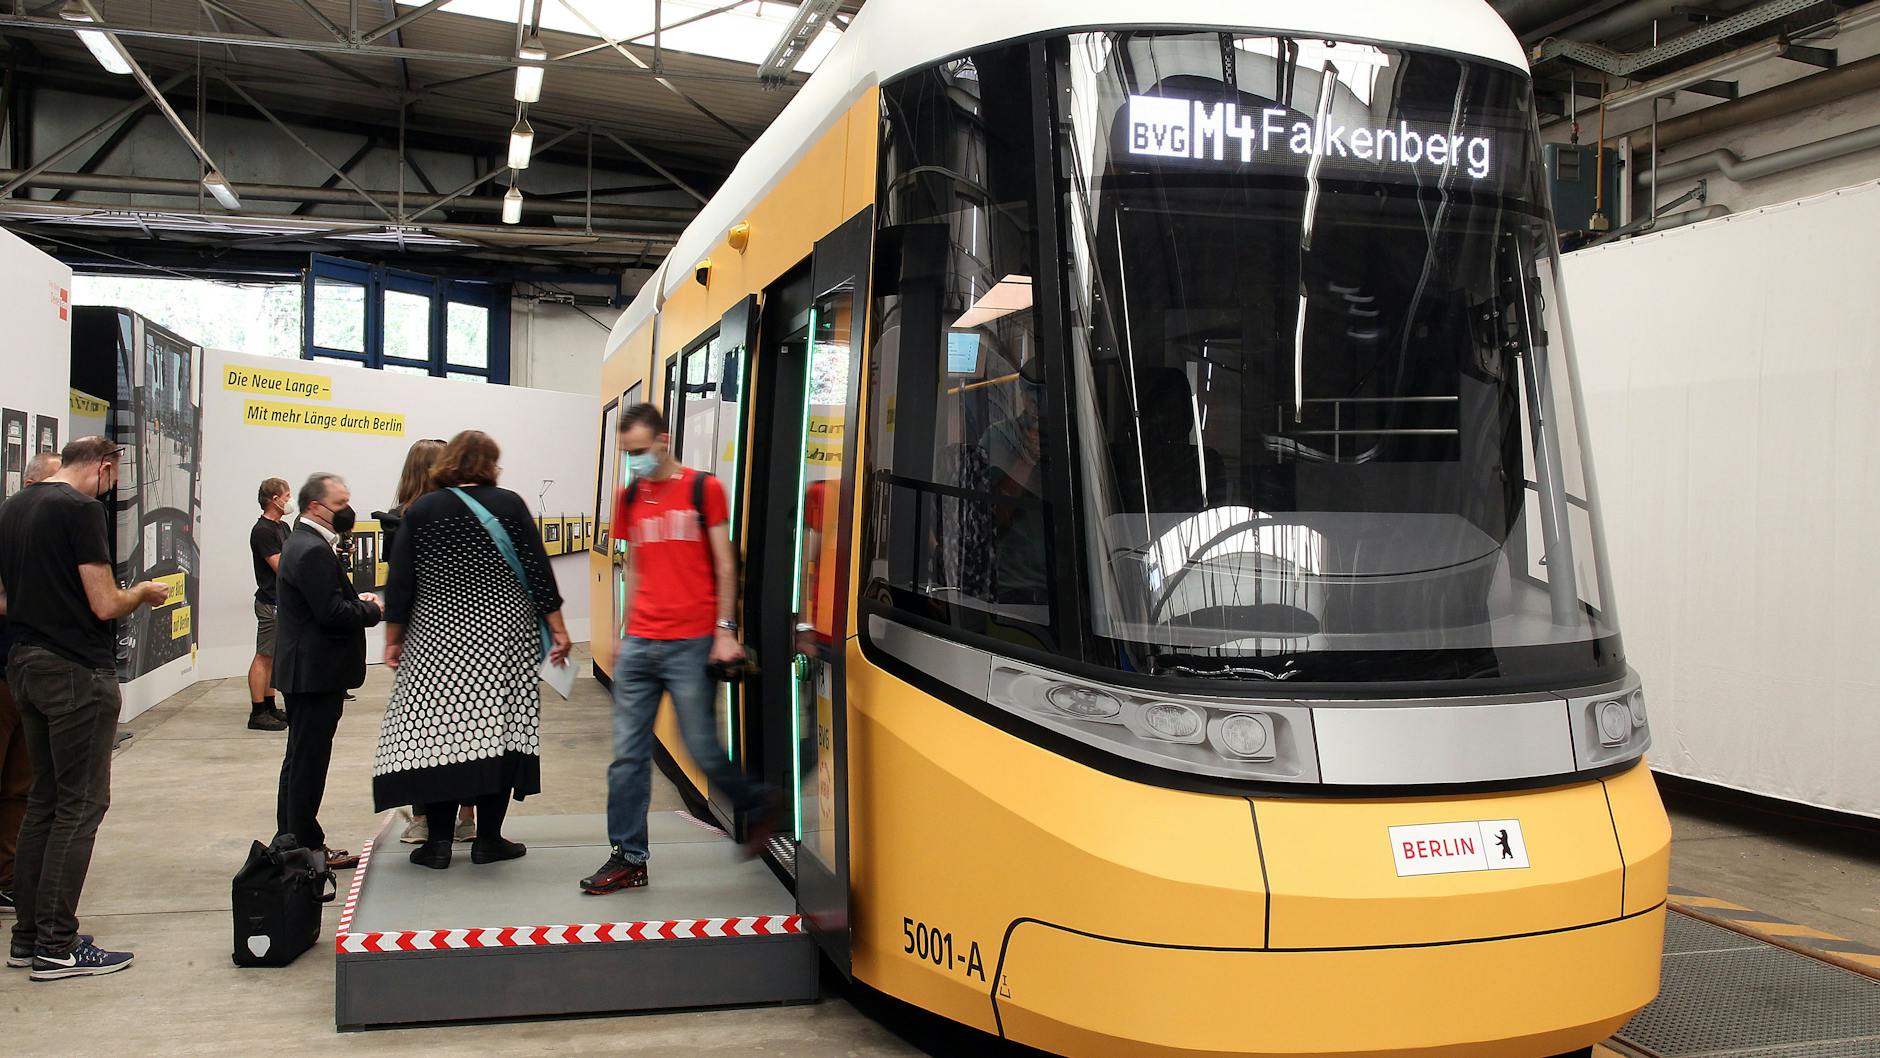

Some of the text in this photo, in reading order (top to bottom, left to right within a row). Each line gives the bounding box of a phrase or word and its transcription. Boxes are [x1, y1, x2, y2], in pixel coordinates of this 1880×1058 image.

[1133, 122, 1186, 153] BVG
[1193, 100, 1255, 162] M4
[228, 371, 248, 386] Die
[251, 374, 282, 390] Neue
[285, 378, 319, 397] Lange
[247, 405, 402, 432] Mit mehr Länge durch Berlin
[818, 724, 830, 750] BVG
[1402, 837, 1475, 859] BERLIN
[903, 916, 986, 982] 5001-A
